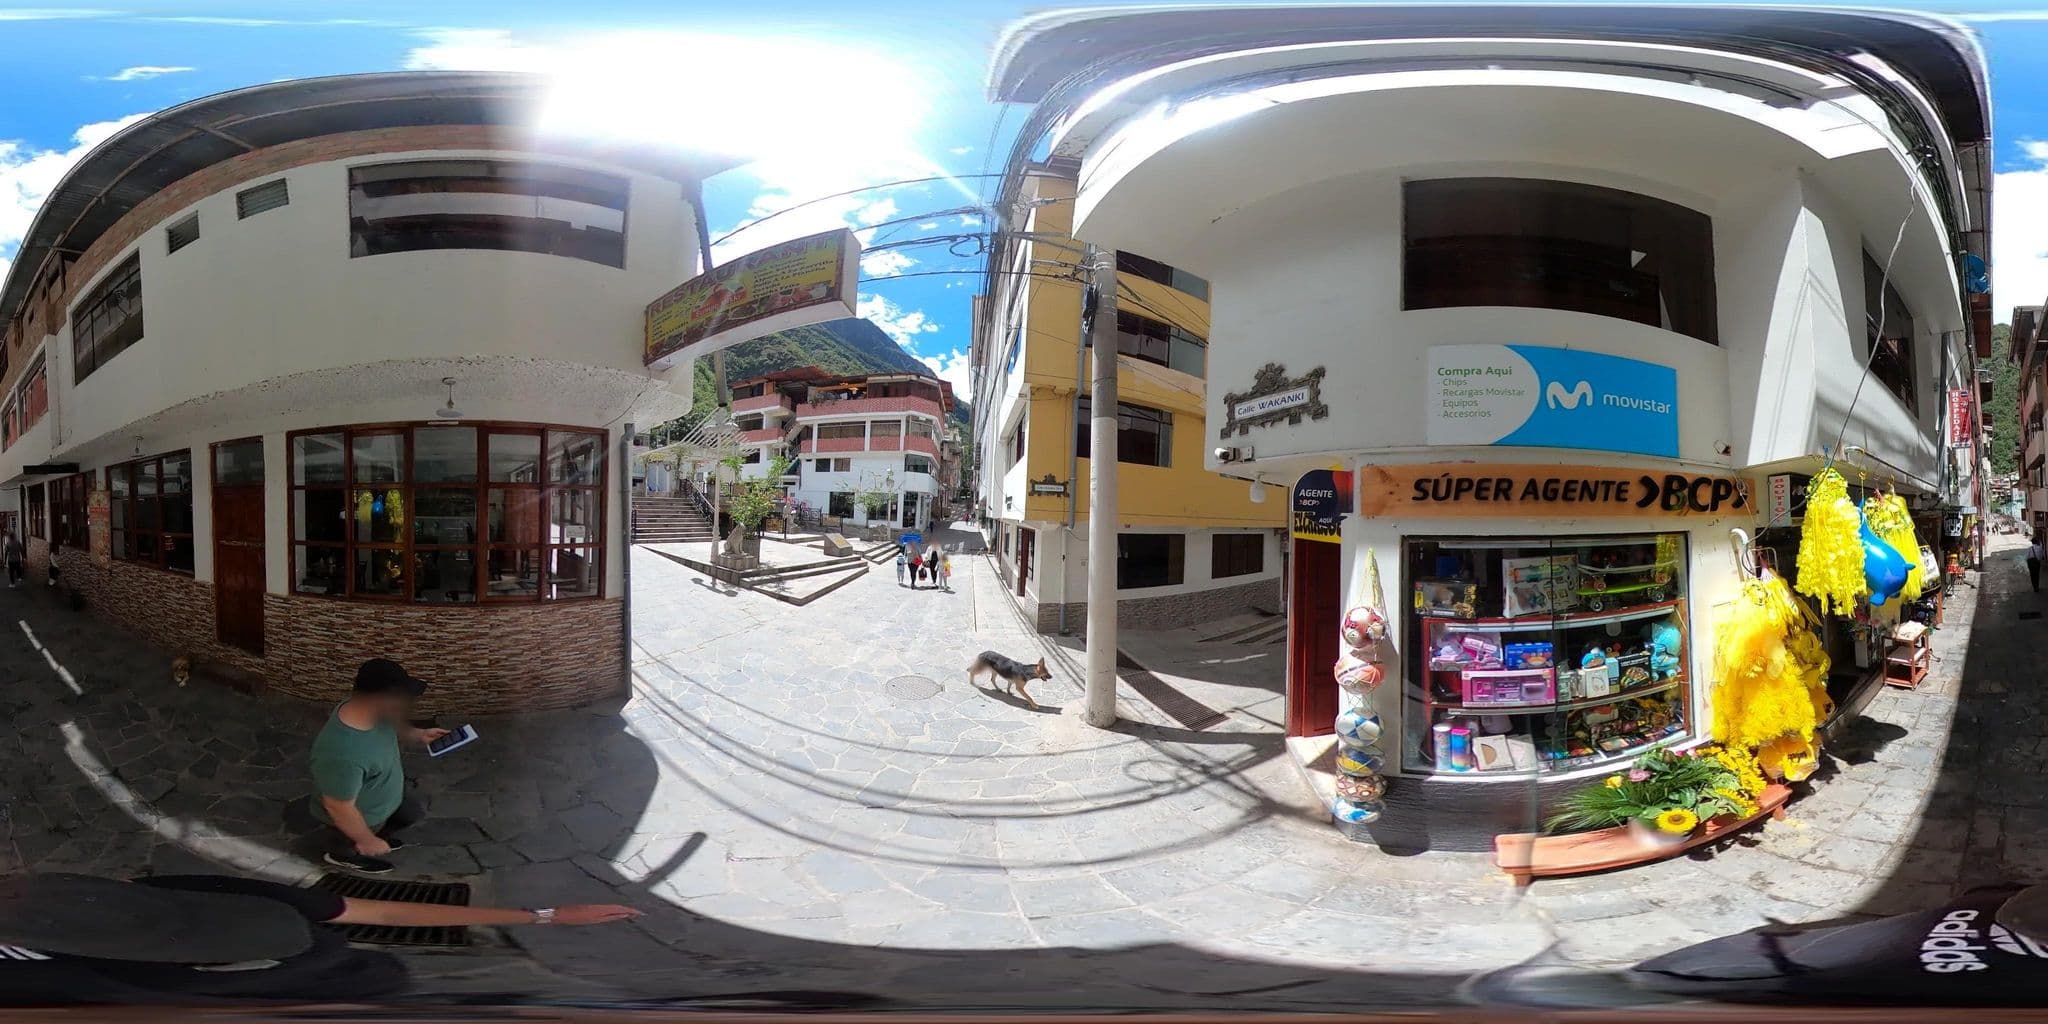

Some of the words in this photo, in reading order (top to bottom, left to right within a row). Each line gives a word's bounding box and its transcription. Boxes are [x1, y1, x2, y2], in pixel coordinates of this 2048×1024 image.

[1437, 367, 1482, 377] Compra
[1442, 378, 1468, 387] Chips
[1442, 388, 1484, 398] Recargas
[1486, 388, 1525, 397] Movistar
[1237, 405, 1256, 416] Calle
[1258, 392, 1304, 410] WAKANKI
[1442, 399, 1479, 408] Equipos
[1603, 394, 1671, 414] movistar
[1442, 410, 1492, 419] Accesorios
[1952, 391, 1960, 442] HOSPEDAJE
[1299, 488, 1333, 498] AGENTE
[1412, 473, 1514, 501] SÚPER
[1520, 477, 1631, 503] AGENTE
[1920, 909, 1989, 973] adidas
